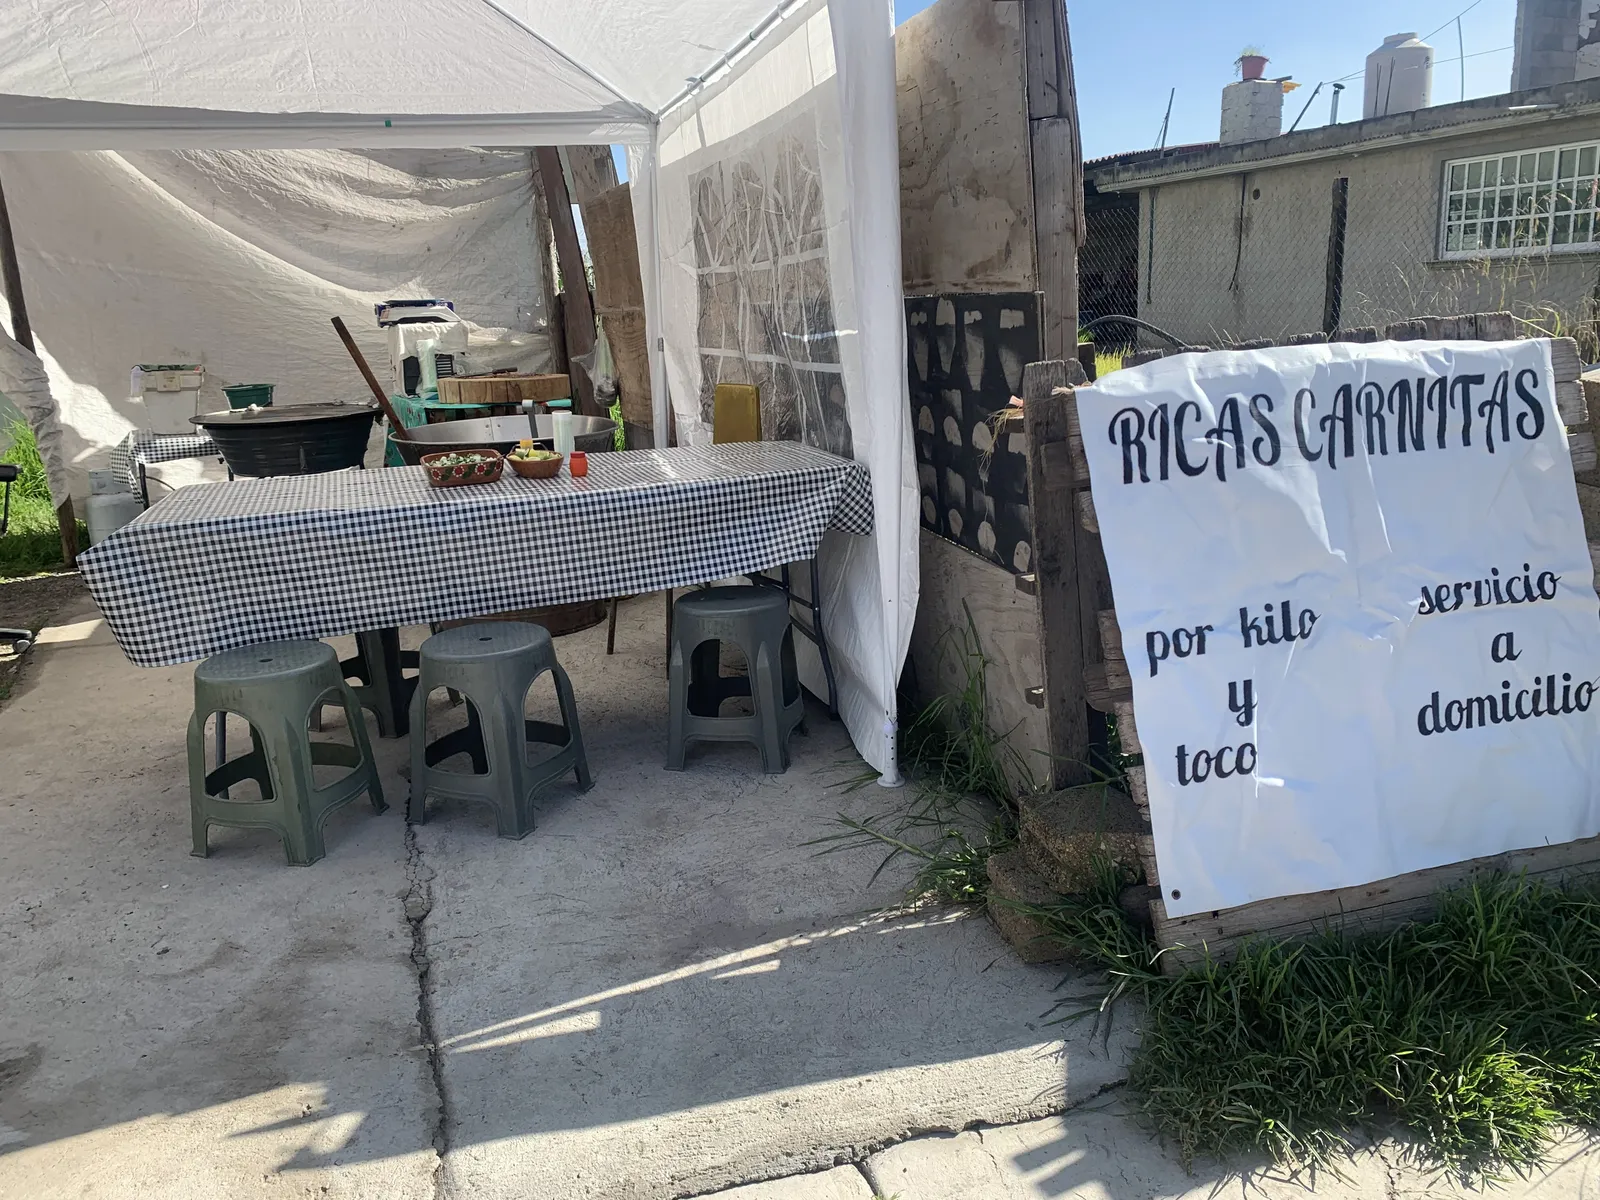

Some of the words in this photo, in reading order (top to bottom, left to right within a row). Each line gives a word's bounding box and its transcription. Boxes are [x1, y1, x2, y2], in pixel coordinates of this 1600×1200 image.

[1108, 394, 1281, 485] RICAS
[1294, 369, 1545, 470] CARNITAS
[1418, 563, 1562, 615] servicio
[1146, 625, 1215, 677] por
[1239, 600, 1321, 648] kilo
[1491, 631, 1522, 663] a
[1228, 678, 1258, 727] y
[1417, 673, 1600, 736] domicilio
[1175, 742, 1257, 786] toco
